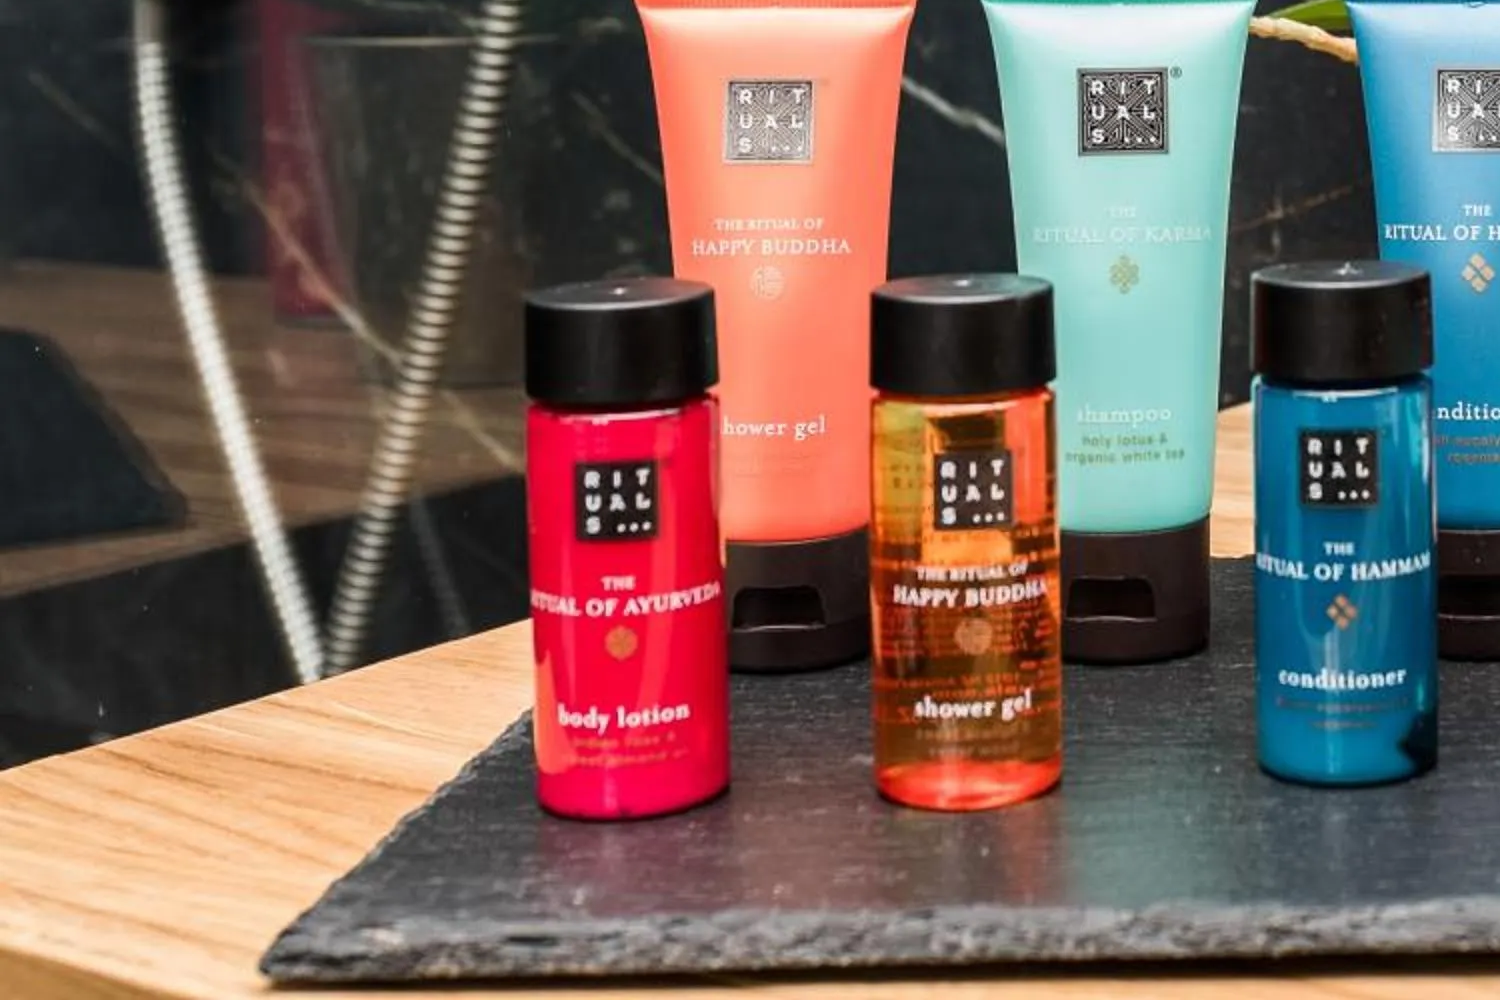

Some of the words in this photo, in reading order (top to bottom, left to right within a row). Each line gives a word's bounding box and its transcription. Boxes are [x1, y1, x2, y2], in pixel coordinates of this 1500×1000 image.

[1463, 205, 1493, 217] THE
[714, 219, 745, 231] THE
[748, 219, 800, 231] RITUAL
[804, 218, 824, 230] OF
[1385, 224, 1447, 242] RITUAL
[1453, 224, 1482, 242] OF
[1033, 227, 1104, 244] RITUAL
[1111, 227, 1139, 243] OF
[691, 239, 756, 257] HAPPY
[761, 239, 850, 256] BUDDHA
[1077, 403, 1172, 428] shampoo
[721, 415, 785, 437] hower
[793, 414, 827, 440] gel
[1322, 541, 1355, 556] THE
[917, 564, 947, 582] THE
[949, 566, 1004, 582] RITUAL
[1007, 561, 1029, 577] OF
[1312, 563, 1345, 582] OF
[1351, 550, 1432, 581] HAMMAM
[601, 575, 636, 592] THE
[893, 583, 961, 608] HAPPY
[964, 579, 1048, 608] BUDDHA
[585, 598, 618, 618] OF
[1278, 668, 1408, 692] conditioner
[913, 694, 997, 720] shower
[1001, 687, 1033, 722] gel
[556, 702, 609, 737] body
[616, 702, 691, 730] lotion
